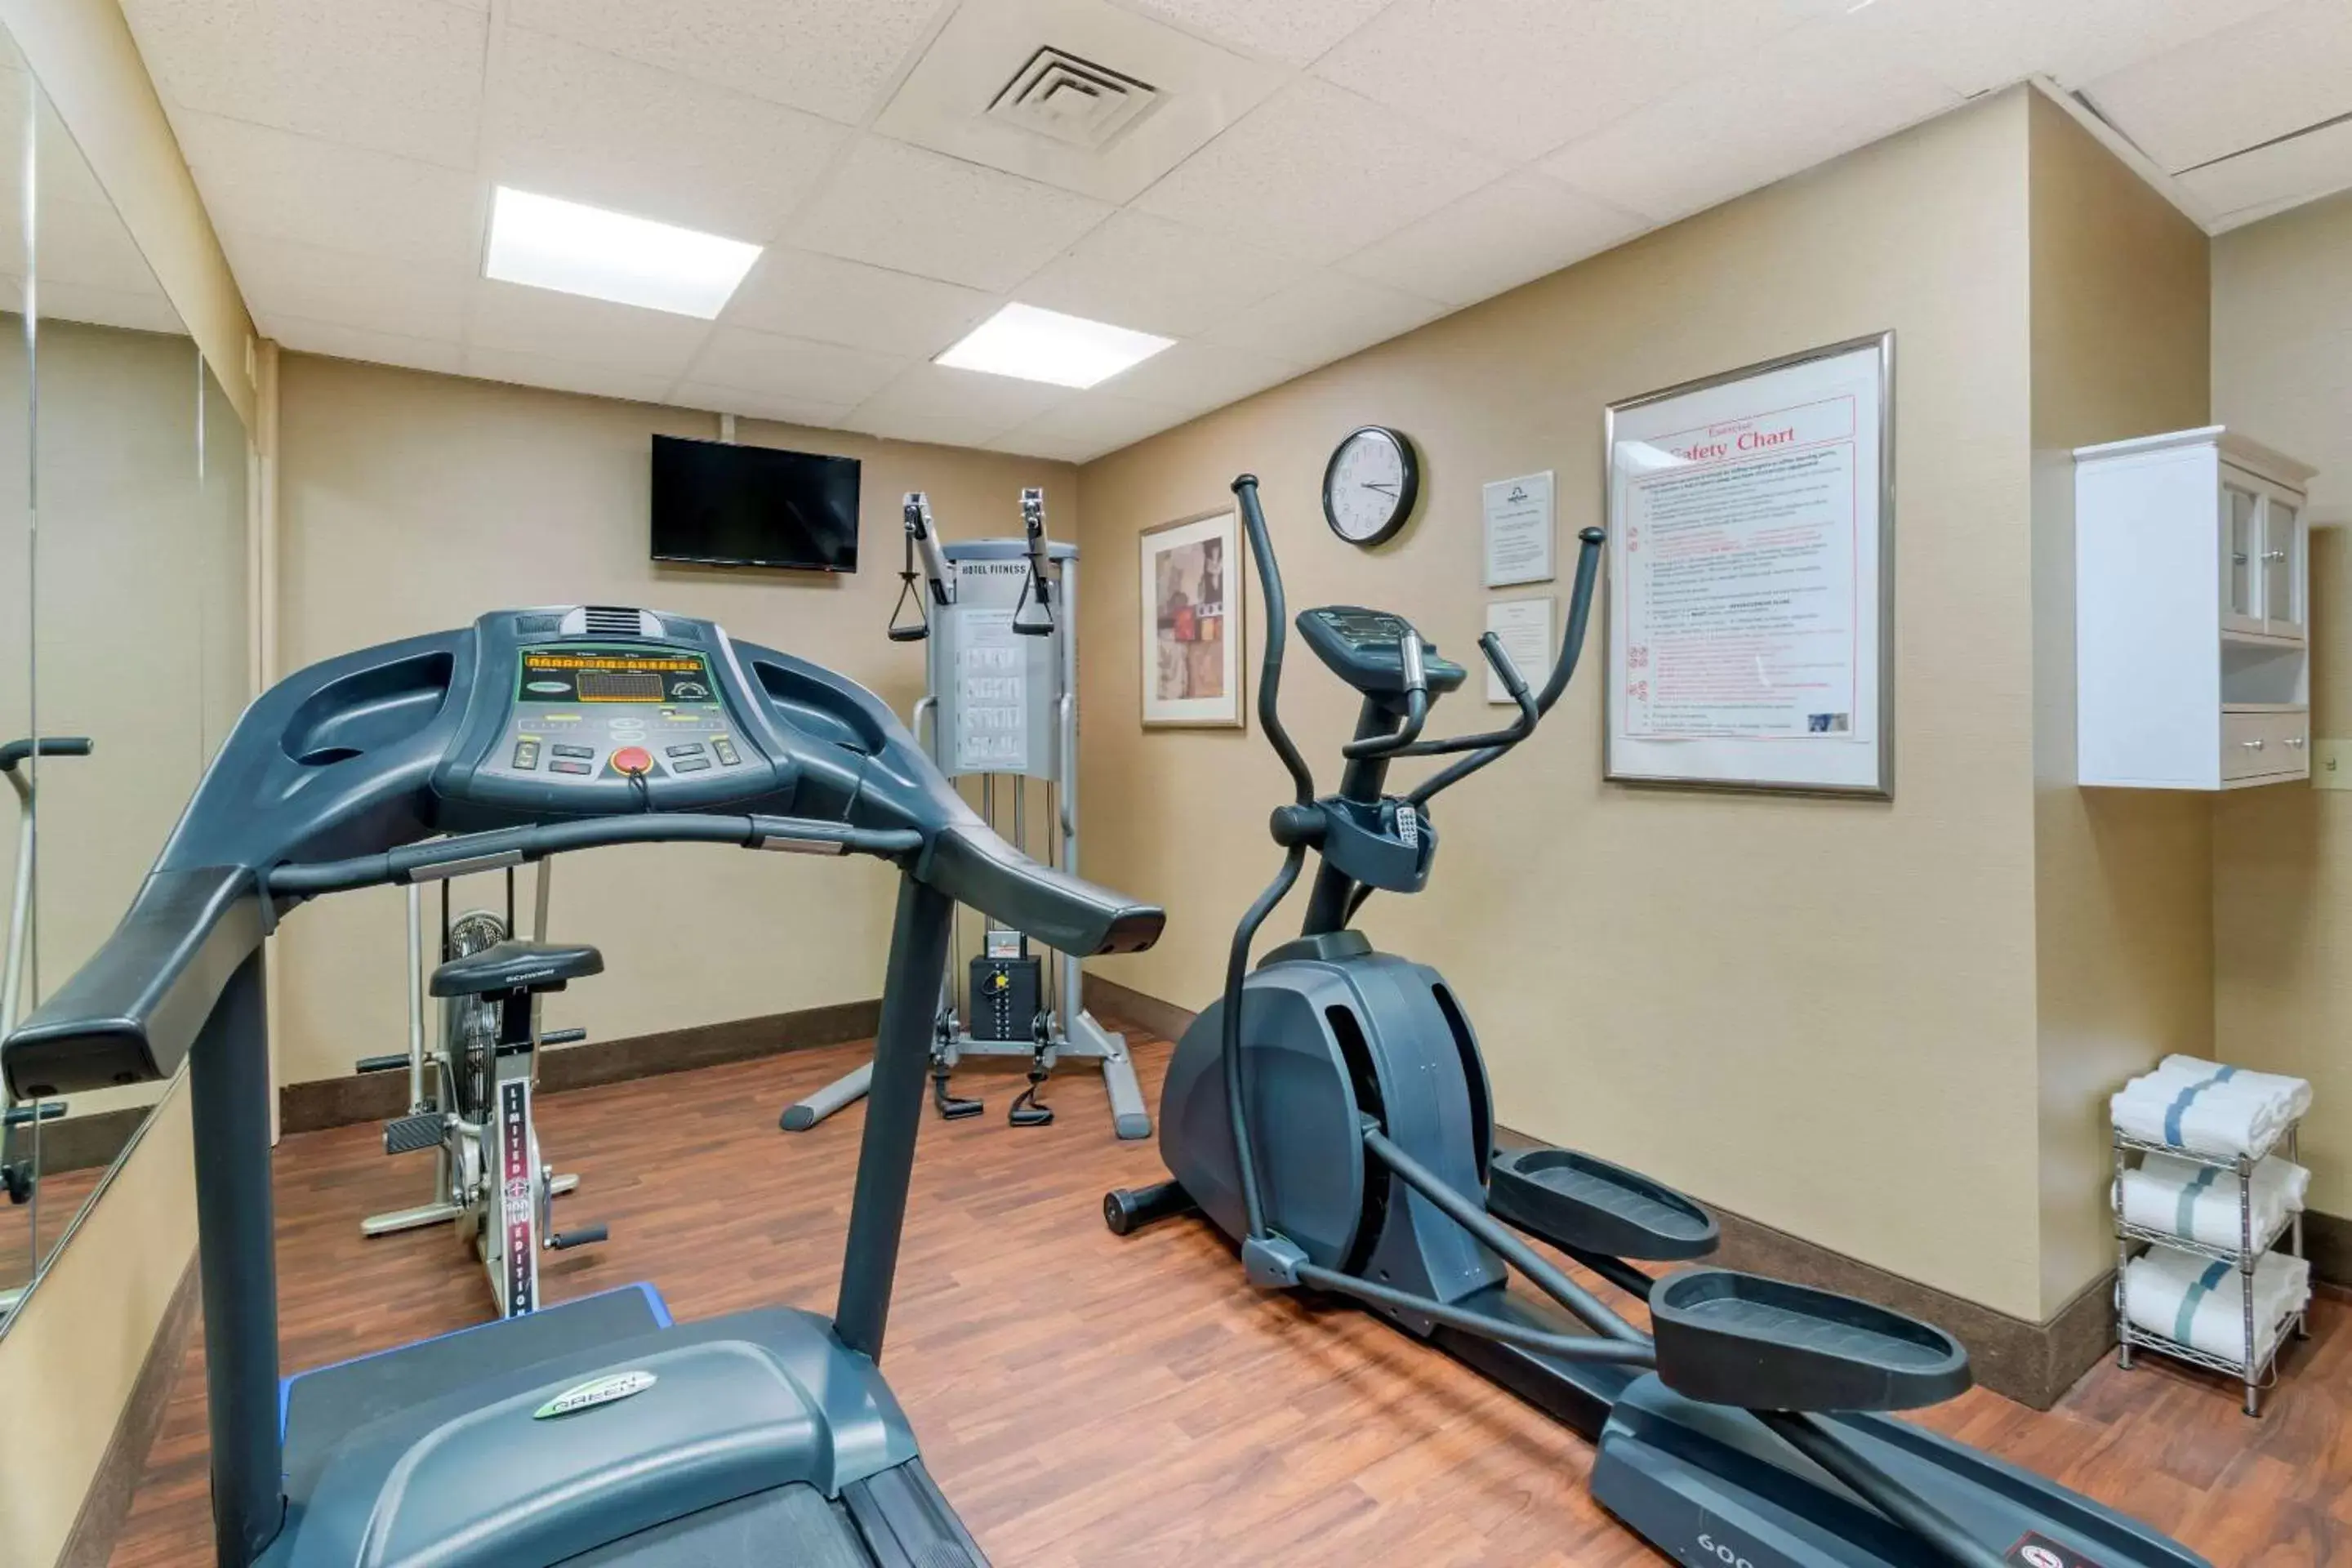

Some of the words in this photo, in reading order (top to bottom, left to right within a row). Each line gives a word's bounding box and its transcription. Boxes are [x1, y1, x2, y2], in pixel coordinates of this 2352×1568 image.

[1737, 425, 1795, 451] Chart
[962, 565, 987, 575] HOTEL
[990, 564, 1027, 575] FITNESS
[509, 1089, 521, 1174] LIMITED
[552, 1375, 637, 1411] GREEN
[1697, 1534, 1755, 1568] 600
